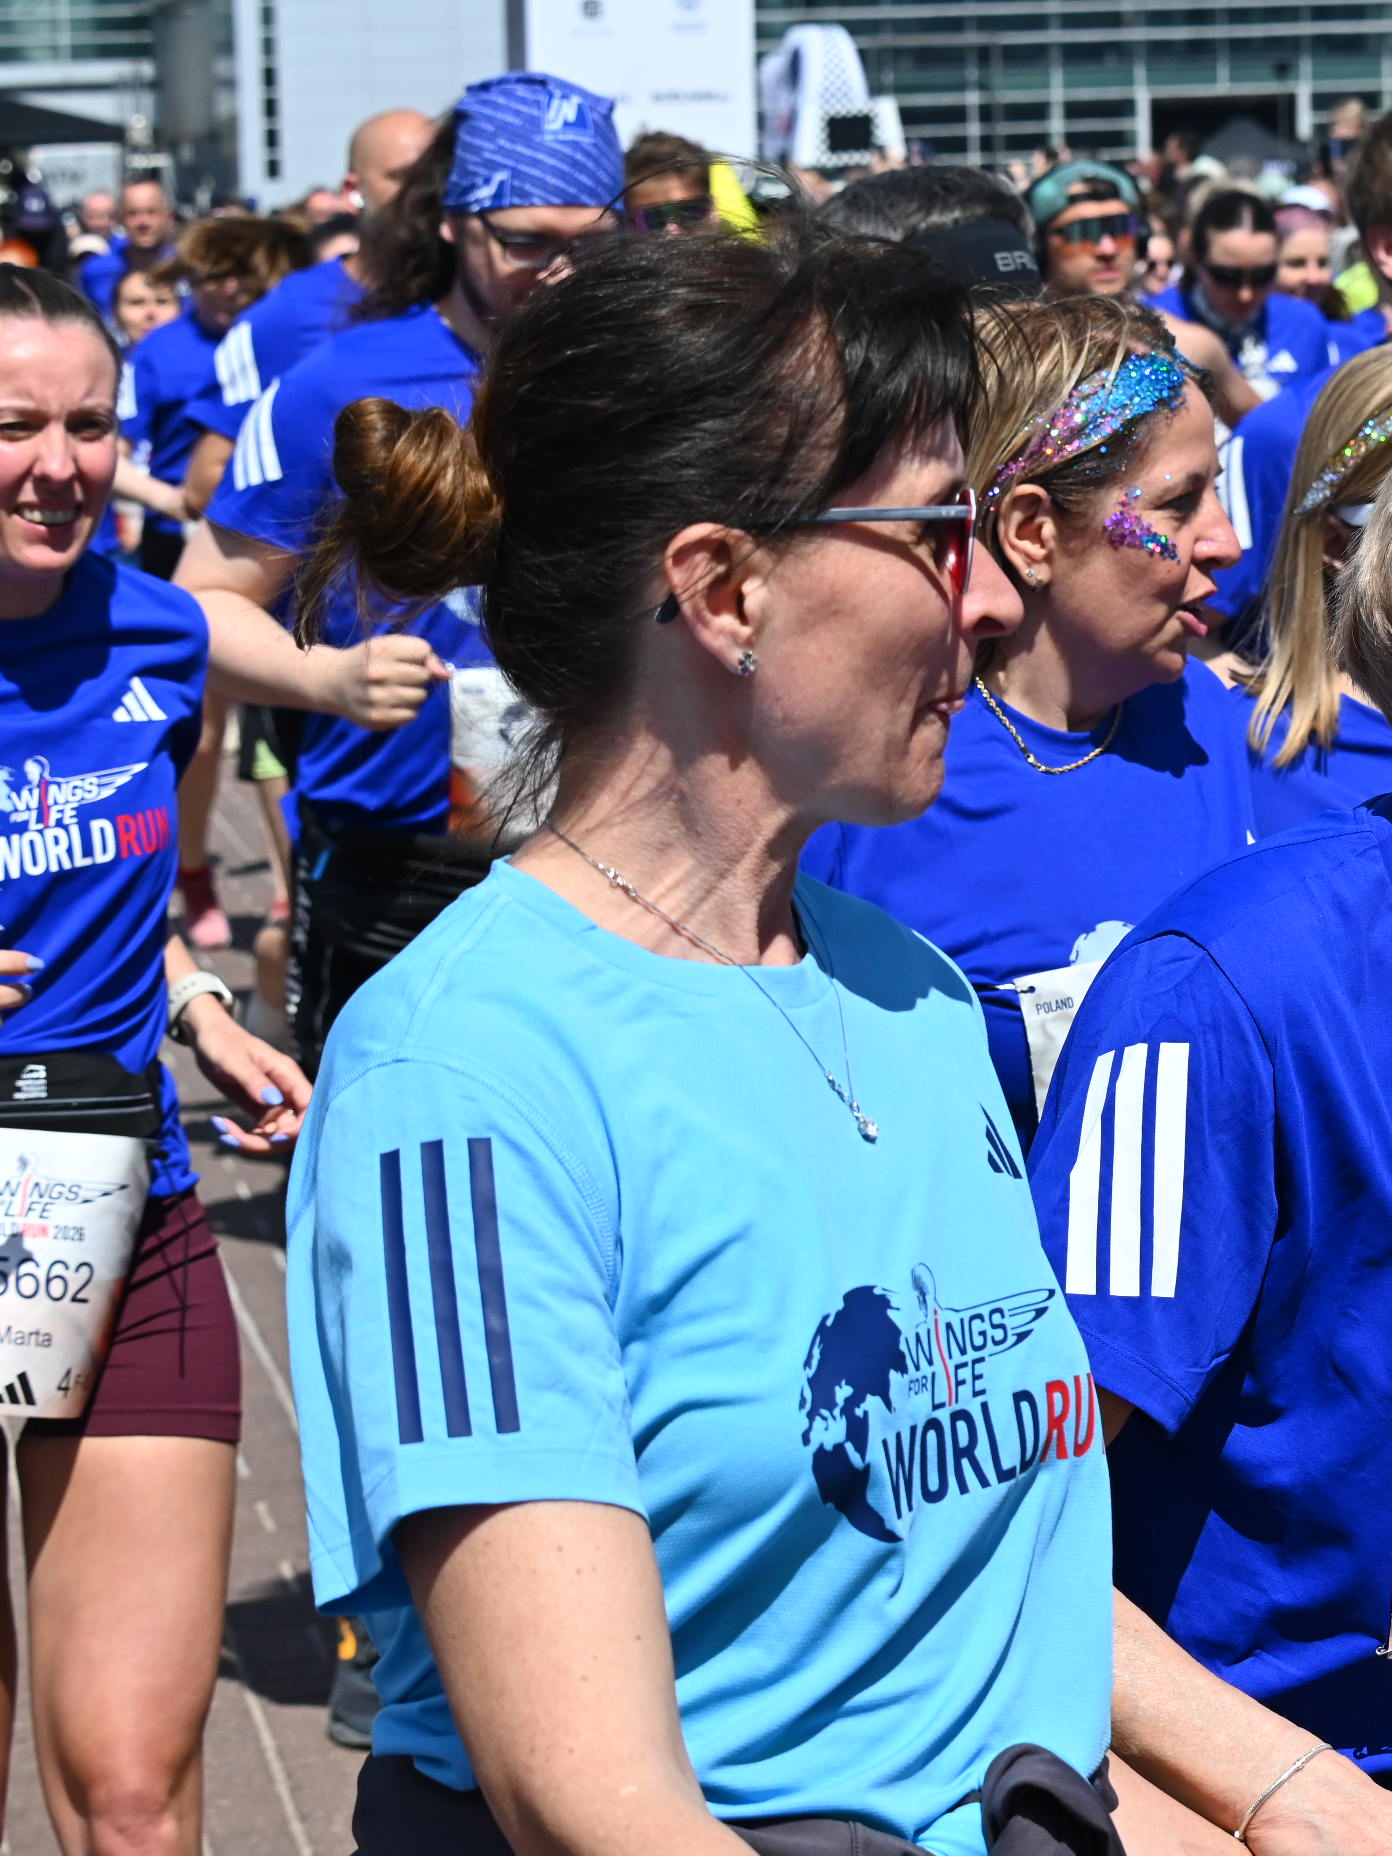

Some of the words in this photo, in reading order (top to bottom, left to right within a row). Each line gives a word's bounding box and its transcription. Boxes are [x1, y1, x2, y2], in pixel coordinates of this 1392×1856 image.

[28, 802, 80, 831] LIFE
[1035, 996, 1074, 1016] POLAND
[5, 1201, 56, 1220] LIFE
[908, 1375, 929, 1396] FOR
[931, 1356, 987, 1412] LIFE
[882, 1373, 1106, 1520] WORLDRU
